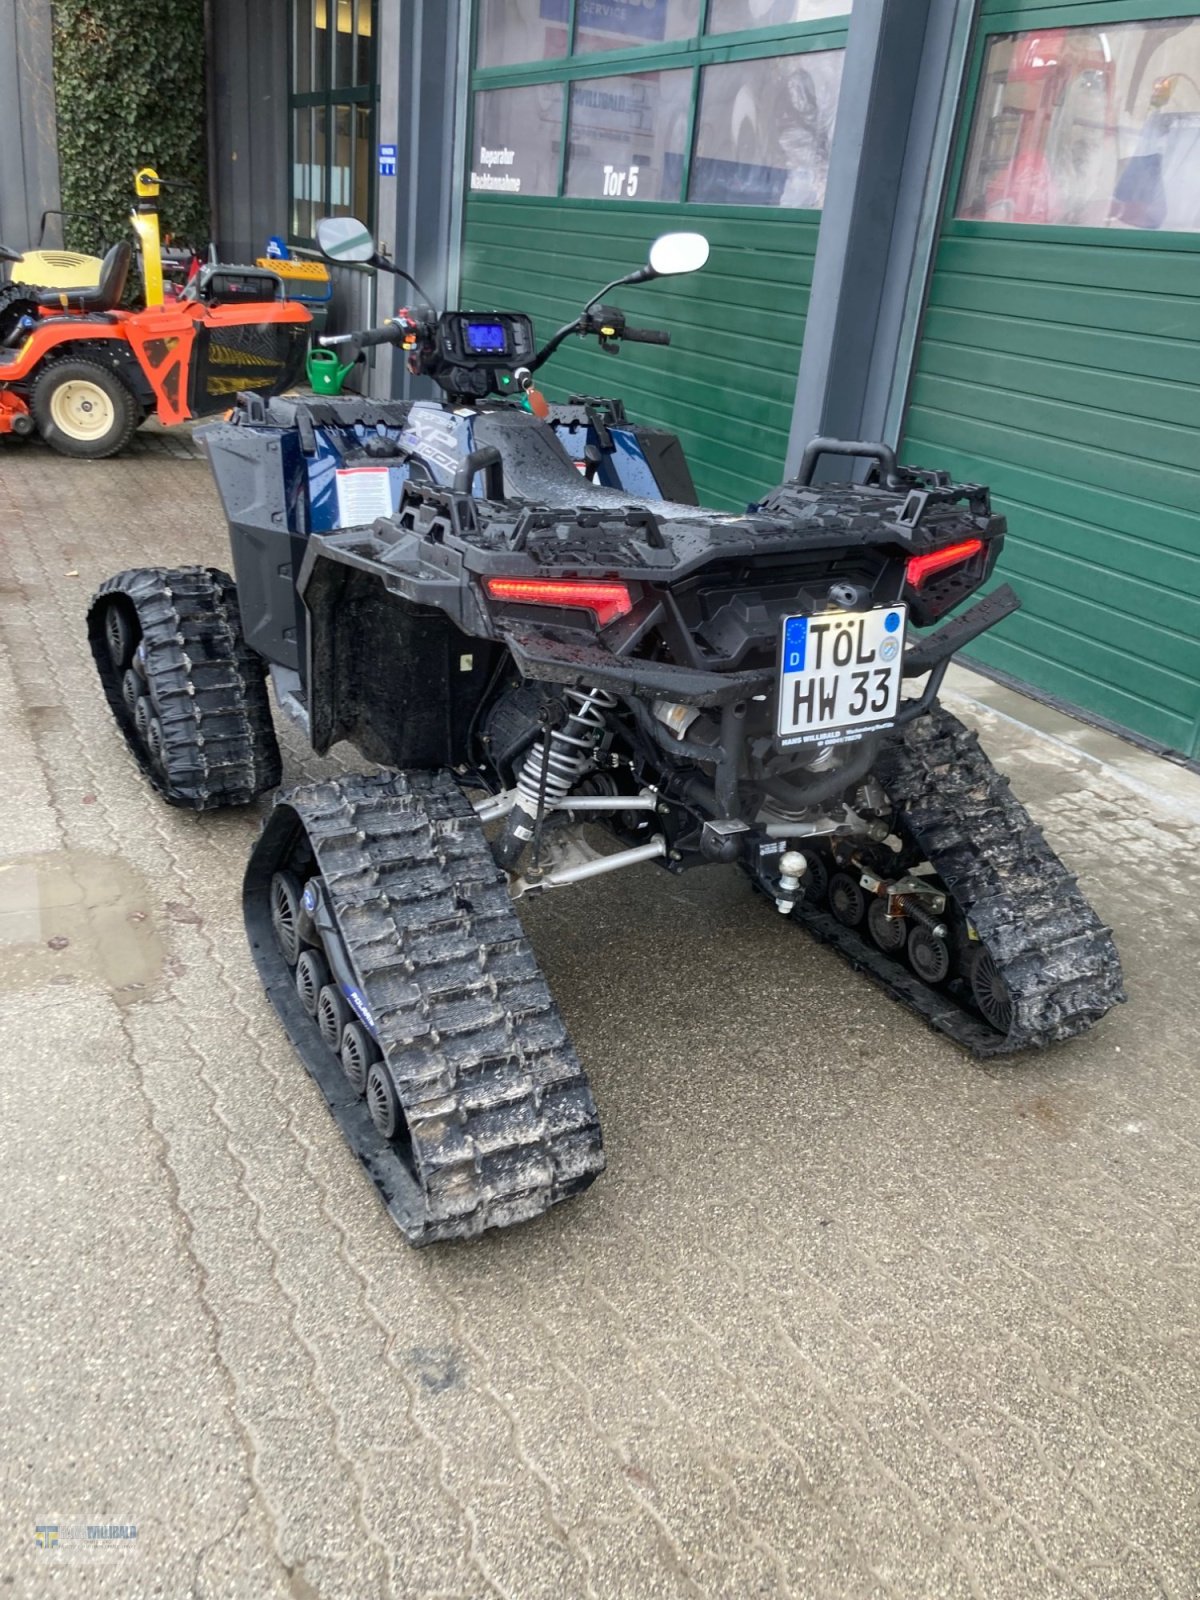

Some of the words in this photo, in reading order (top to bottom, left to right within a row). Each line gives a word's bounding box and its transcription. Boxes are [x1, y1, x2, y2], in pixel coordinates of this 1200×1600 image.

[582, 2, 627, 21] SERVICE
[603, 165, 626, 196] Tor
[626, 166, 640, 197] 5
[402, 420, 458, 448] XP
[789, 652, 801, 667] D
[810, 619, 876, 670] TÖL
[792, 675, 839, 726] HW
[848, 668, 892, 716] 33
[781, 737, 803, 747] HANS
[803, 731, 841, 744] WILLIBALD
[350, 991, 375, 1026] POLARIS
